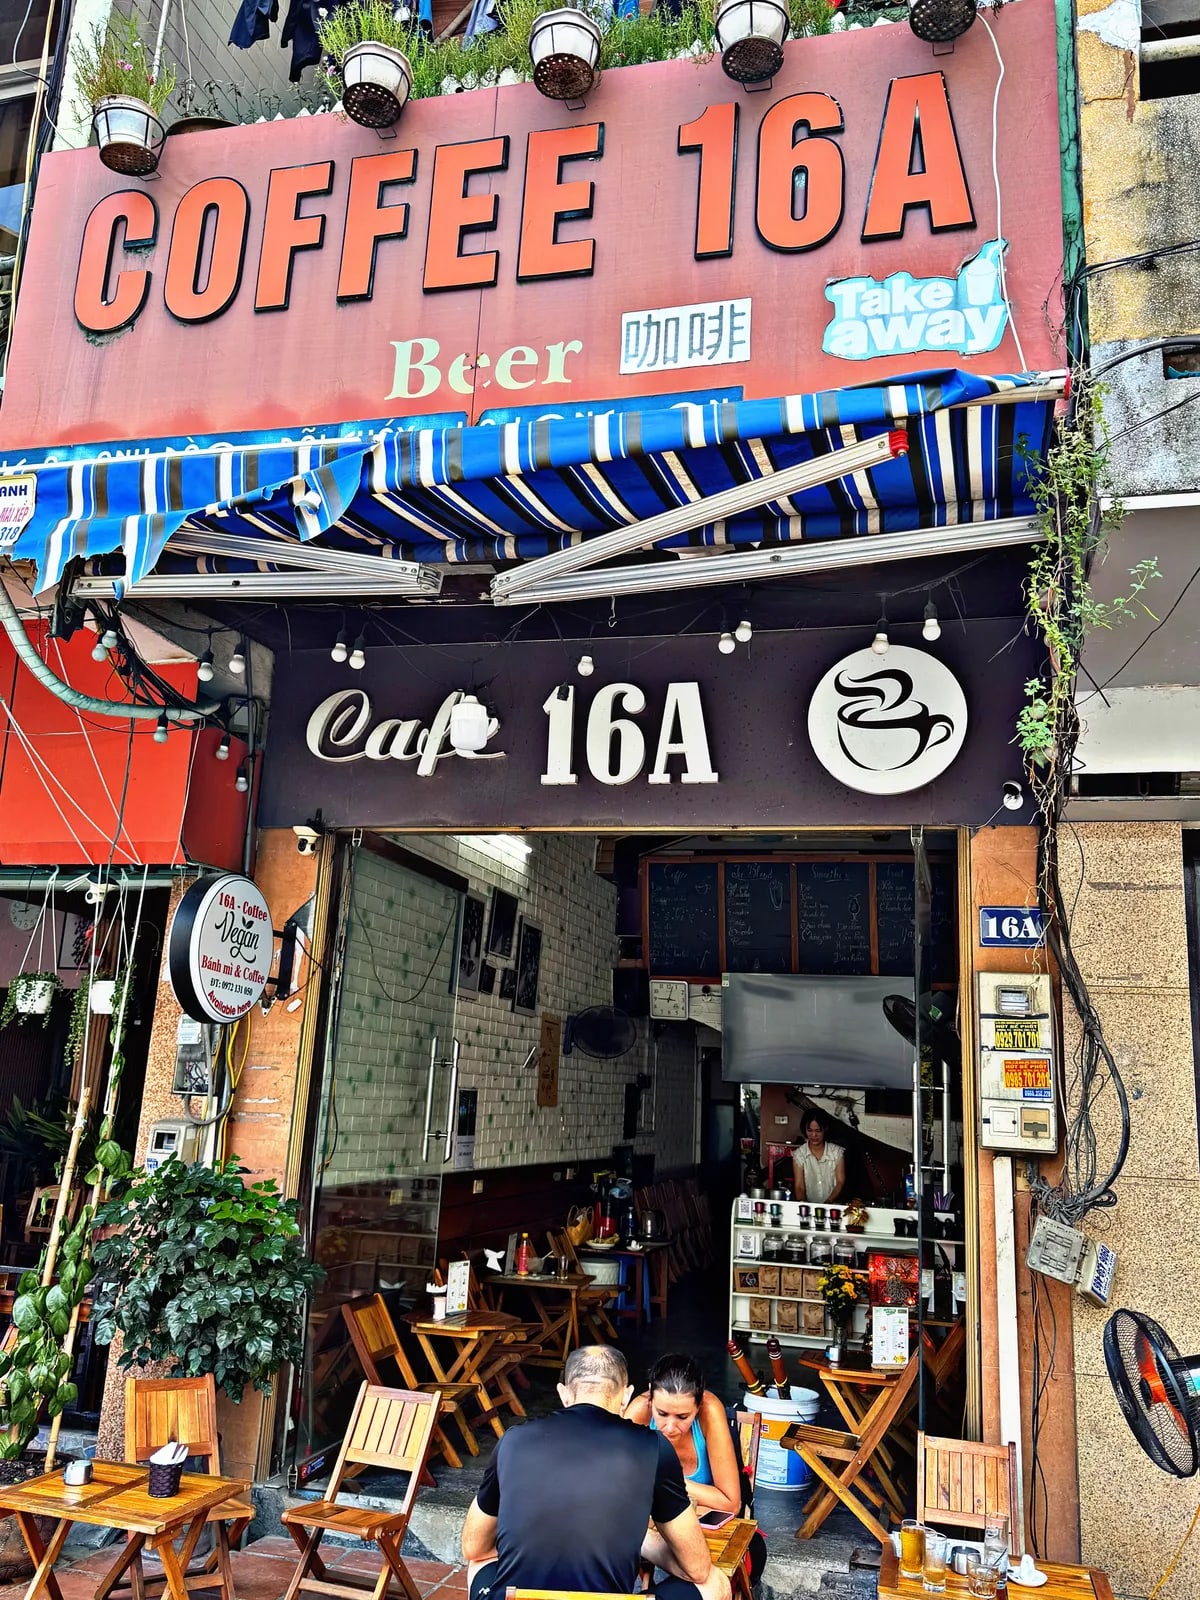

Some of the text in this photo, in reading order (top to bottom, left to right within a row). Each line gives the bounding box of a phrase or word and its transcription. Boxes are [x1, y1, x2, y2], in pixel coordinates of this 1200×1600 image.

[73, 70, 977, 332] COFFEE 16A
[832, 278, 954, 319] Take
[624, 304, 746, 368] 咖啡
[829, 305, 1005, 355] away
[384, 337, 583, 402] Beer
[541, 682, 720, 786] 16A
[219, 892, 235, 910] 16A
[242, 900, 268, 921] Coffee
[984, 916, 1041, 939] 16A
[215, 911, 259, 963] Vegan
[201, 954, 222, 973] Bánh
[234, 964, 242, 978] &
[243, 967, 265, 985] Coffee
[208, 990, 252, 1015] Available here
